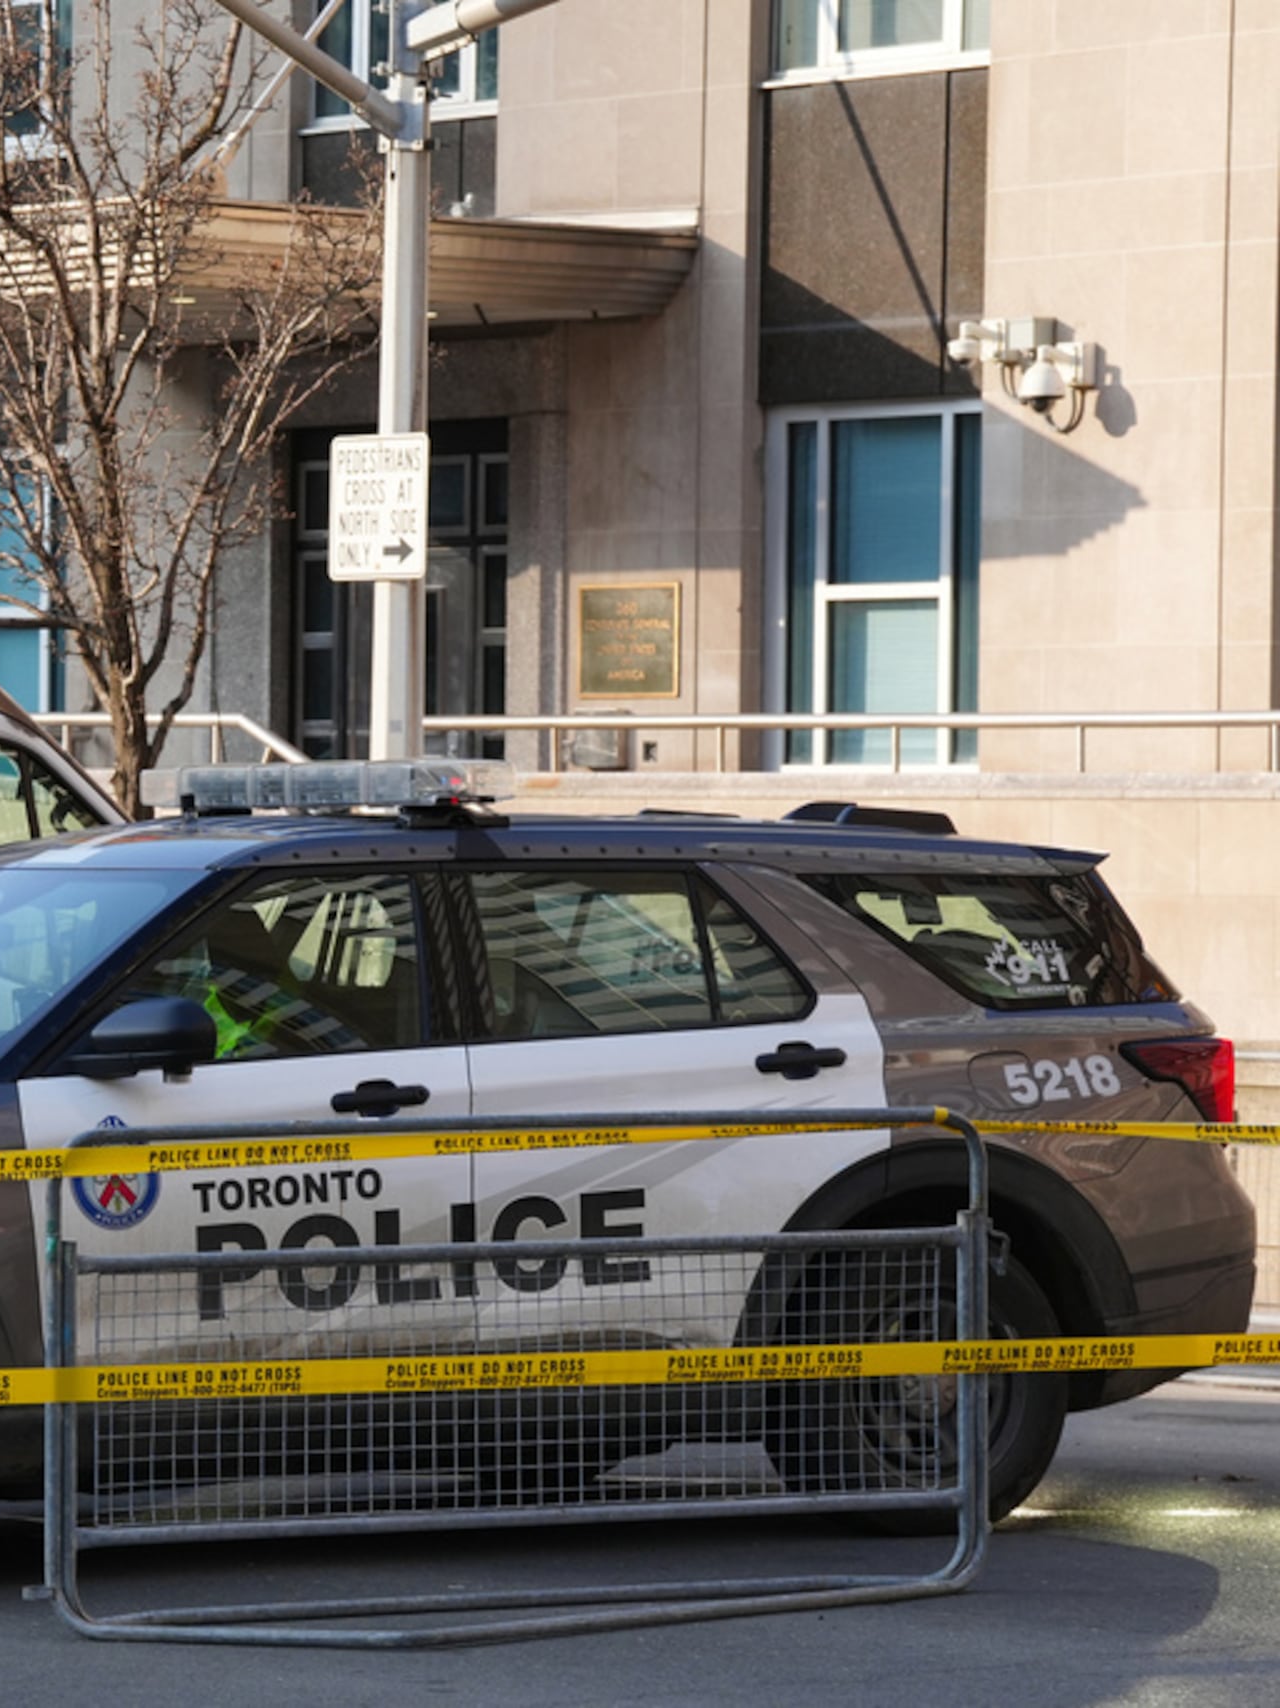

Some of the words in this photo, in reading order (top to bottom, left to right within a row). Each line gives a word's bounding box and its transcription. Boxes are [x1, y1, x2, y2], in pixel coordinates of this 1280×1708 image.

[337, 447, 421, 473] PEDESTRIANS
[345, 479, 385, 505] CROSS
[397, 477, 413, 503] AT
[339, 510, 379, 536] NORTH
[391, 509, 417, 534] SIDE
[338, 542, 371, 568] ONLY
[1004, 1054, 1121, 1104] 5218
[14, 1155, 62, 1170] CROSS
[150, 1149, 199, 1163] POLICE
[207, 1147, 239, 1161] LINE
[272, 1145, 298, 1158] NOT
[304, 1143, 350, 1157] CROSS
[192, 1168, 383, 1213] TORONTO
[194, 1188, 651, 1322] POLICE
[945, 1347, 993, 1360] POLICE
[1000, 1346, 1029, 1359] LINE
[1035, 1345, 1053, 1358] DO
[1059, 1344, 1084, 1358] NOT
[1091, 1343, 1135, 1357] CROSS
[1215, 1340, 1262, 1353] POLICE
[387, 1363, 437, 1377] POLICE
[444, 1362, 475, 1375] LINE
[482, 1361, 500, 1374] DO
[507, 1360, 533, 1374] NOT
[540, 1359, 585, 1373] CROSS
[668, 1355, 717, 1368] POLICE
[724, 1354, 755, 1367] LINE
[762, 1353, 780, 1366] DO
[787, 1352, 812, 1365] NOT
[819, 1351, 863, 1364] CROSS
[97, 1371, 149, 1386] POLICE
[156, 1370, 188, 1384] LINE
[196, 1369, 214, 1383] DO
[221, 1368, 248, 1382] NOT
[255, 1367, 302, 1381] CROSS
[96, 1387, 128, 1399] Crime
